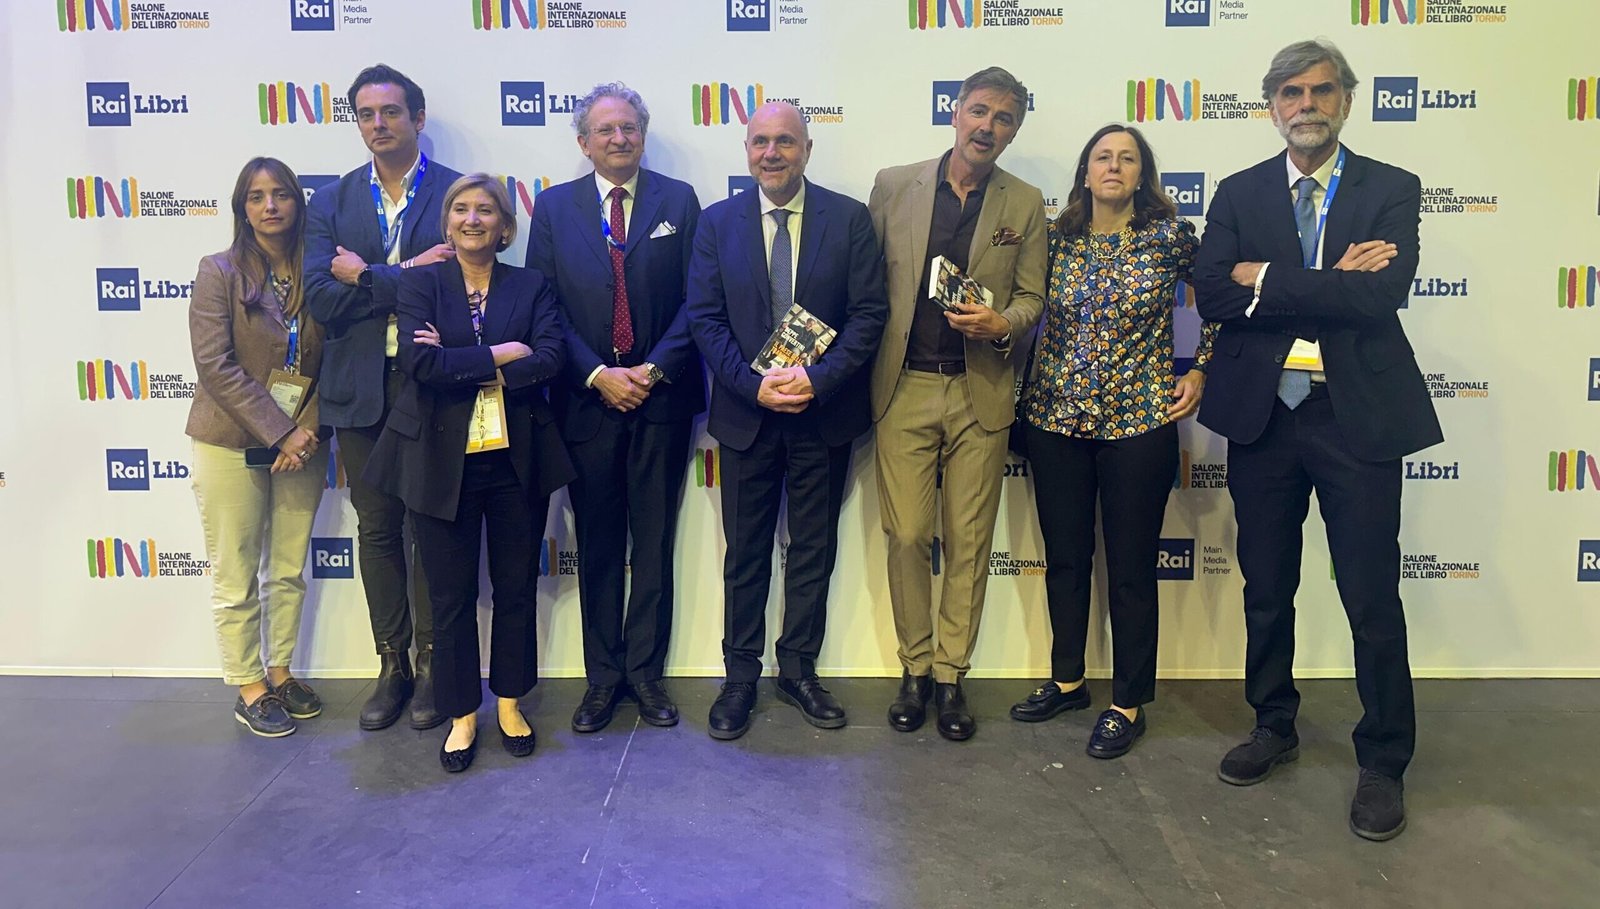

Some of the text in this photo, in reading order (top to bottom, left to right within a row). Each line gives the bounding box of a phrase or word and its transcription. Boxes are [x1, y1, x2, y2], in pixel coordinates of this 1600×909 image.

[547, 2, 582, 10] SALONE
[983, 0, 1019, 8] SALONE
[1170, 0, 1205, 14] Rai
[1220, 0, 1244, 8] Media
[296, 0, 330, 18] Rai
[344, 5, 367, 13] Media
[731, 0, 765, 18] Rai
[780, 5, 804, 13] Media
[984, 8, 1063, 17] INTERNAZIONALE
[1427, 6, 1506, 14] INTERNAZIONALE
[131, 12, 209, 20] INTERNAZIONALE
[548, 11, 626, 20] INTERNAZIONALE
[1220, 12, 1248, 20] Partner
[1426, 15, 1506, 23] DEL LIBRO TORINO
[344, 16, 372, 24] Partner
[548, 20, 627, 28] DEL LIBRO TORINO
[780, 16, 808, 24] Partner
[984, 17, 1063, 26] DEL LIBRO TORINO
[132, 20, 210, 29] DEL LIBRO TORINO
[332, 97, 349, 105] SAL
[1202, 94, 1238, 102] SALONE
[1378, 89, 1476, 109] Rai Libri
[92, 94, 188, 114] Rai Libri
[506, 94, 540, 113] Rai
[800, 107, 843, 115] AZIONALE
[1202, 111, 1270, 119] DEL LIBRO TORI
[812, 115, 844, 123] TORINO
[140, 192, 174, 200] SALONE
[1165, 184, 1200, 204] Rai
[1420, 188, 1454, 196] SALONE
[141, 200, 217, 208] INTERNAZIONALE
[1421, 196, 1497, 204] NTERNAZIONALE
[141, 208, 218, 216] DEL LIBRO TORINO
[1420, 205, 1497, 213] DEL LIBRO TORINO
[101, 280, 194, 299] Rai Libri
[1413, 278, 1467, 296] Libri
[150, 374, 183, 382] SALONE
[1426, 382, 1488, 390] ERNAZIONALE
[1458, 390, 1488, 398] TORINO
[111, 460, 189, 479] Rai Lib
[1192, 464, 1226, 472] SALONE
[1405, 462, 1459, 479] Libri
[316, 549, 350, 567] Rai
[1157, 550, 1190, 568] Rai
[990, 560, 1046, 568] ERNAZIONAL
[1402, 563, 1480, 571] INTERNAZIONALE
[559, 567, 575, 575] DEL
[994, 568, 1020, 576] LIBRO
[1022, 568, 1046, 576] TORIN
[1402, 571, 1419, 579] DEL
[1421, 571, 1447, 579] LIBRO
